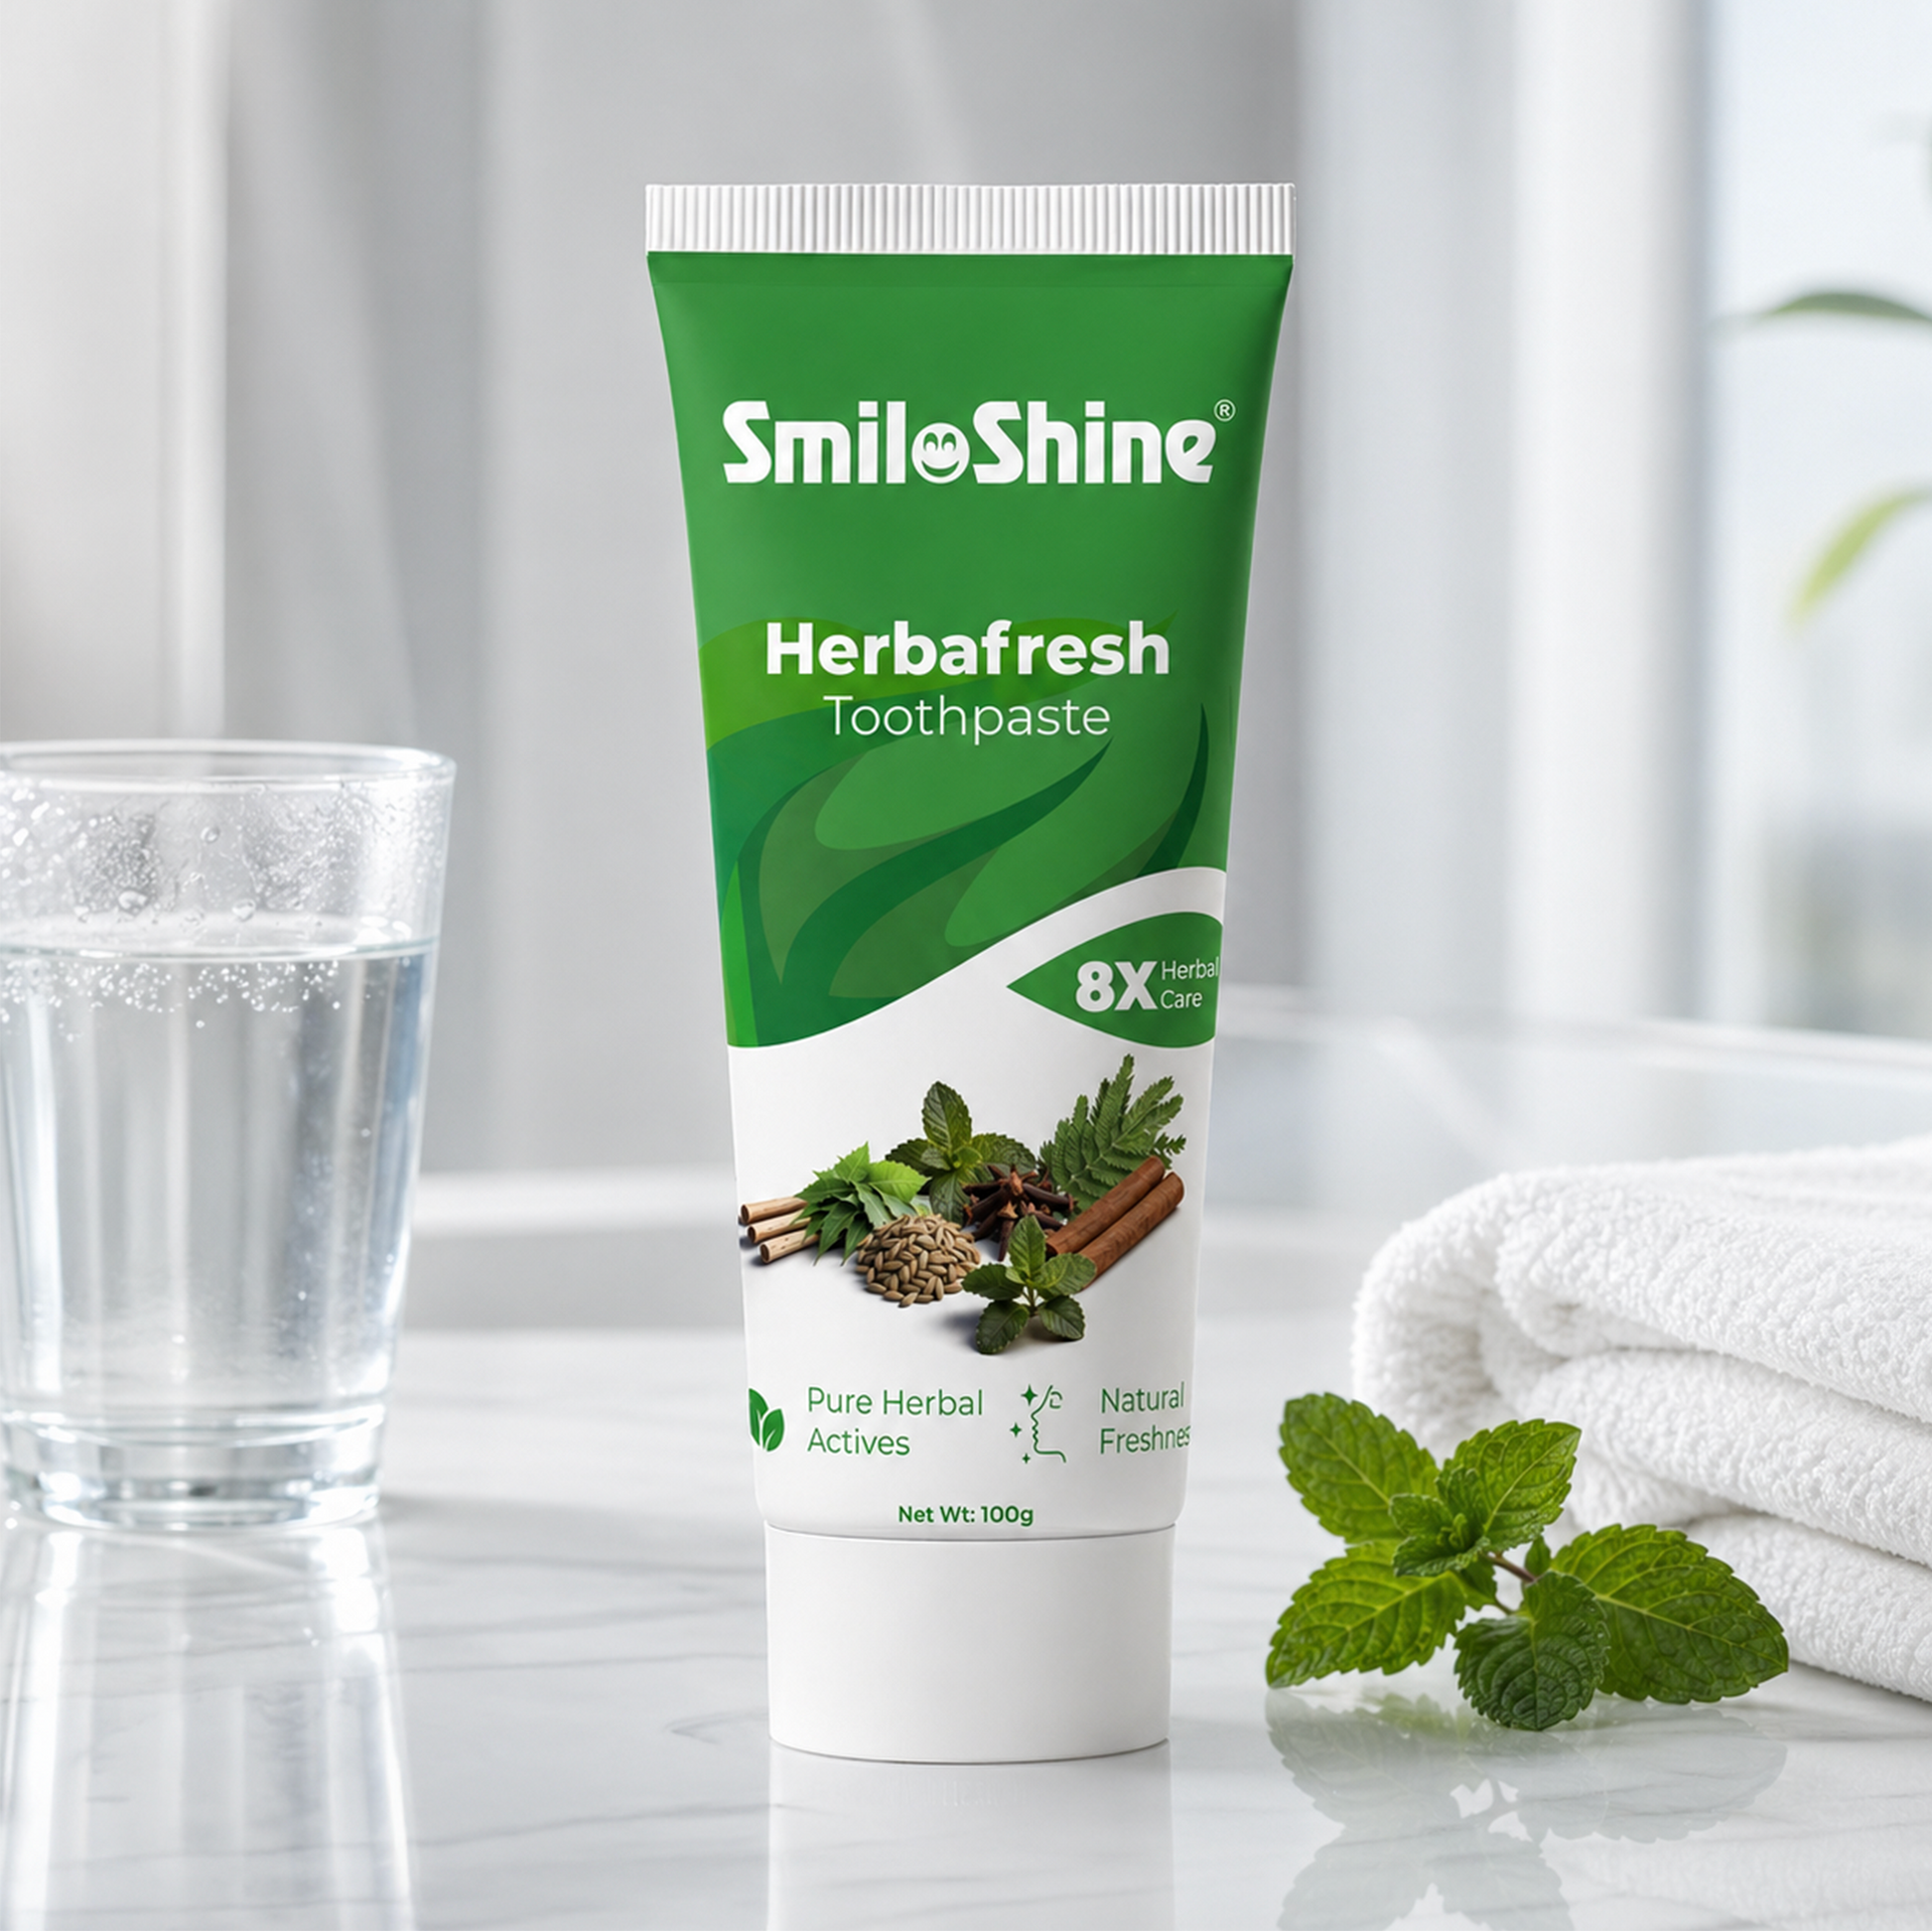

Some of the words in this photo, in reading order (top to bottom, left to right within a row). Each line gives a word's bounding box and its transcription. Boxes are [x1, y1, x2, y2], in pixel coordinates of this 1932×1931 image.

[766, 621, 1170, 675] Herbafresh
[823, 696, 1111, 746] Toothpaste
[1162, 956, 1219, 980] Herbal
[1075, 960, 1159, 1013] 8X
[1161, 990, 1202, 1010] Care
[808, 1386, 873, 1414] Pure
[883, 1389, 983, 1416] Herbal
[1101, 1381, 1184, 1414] Natural
[807, 1427, 910, 1455] Actives
[898, 1505, 934, 1522] Net
[939, 1505, 976, 1523] Wt:
[981, 1505, 1035, 1527] 100g
